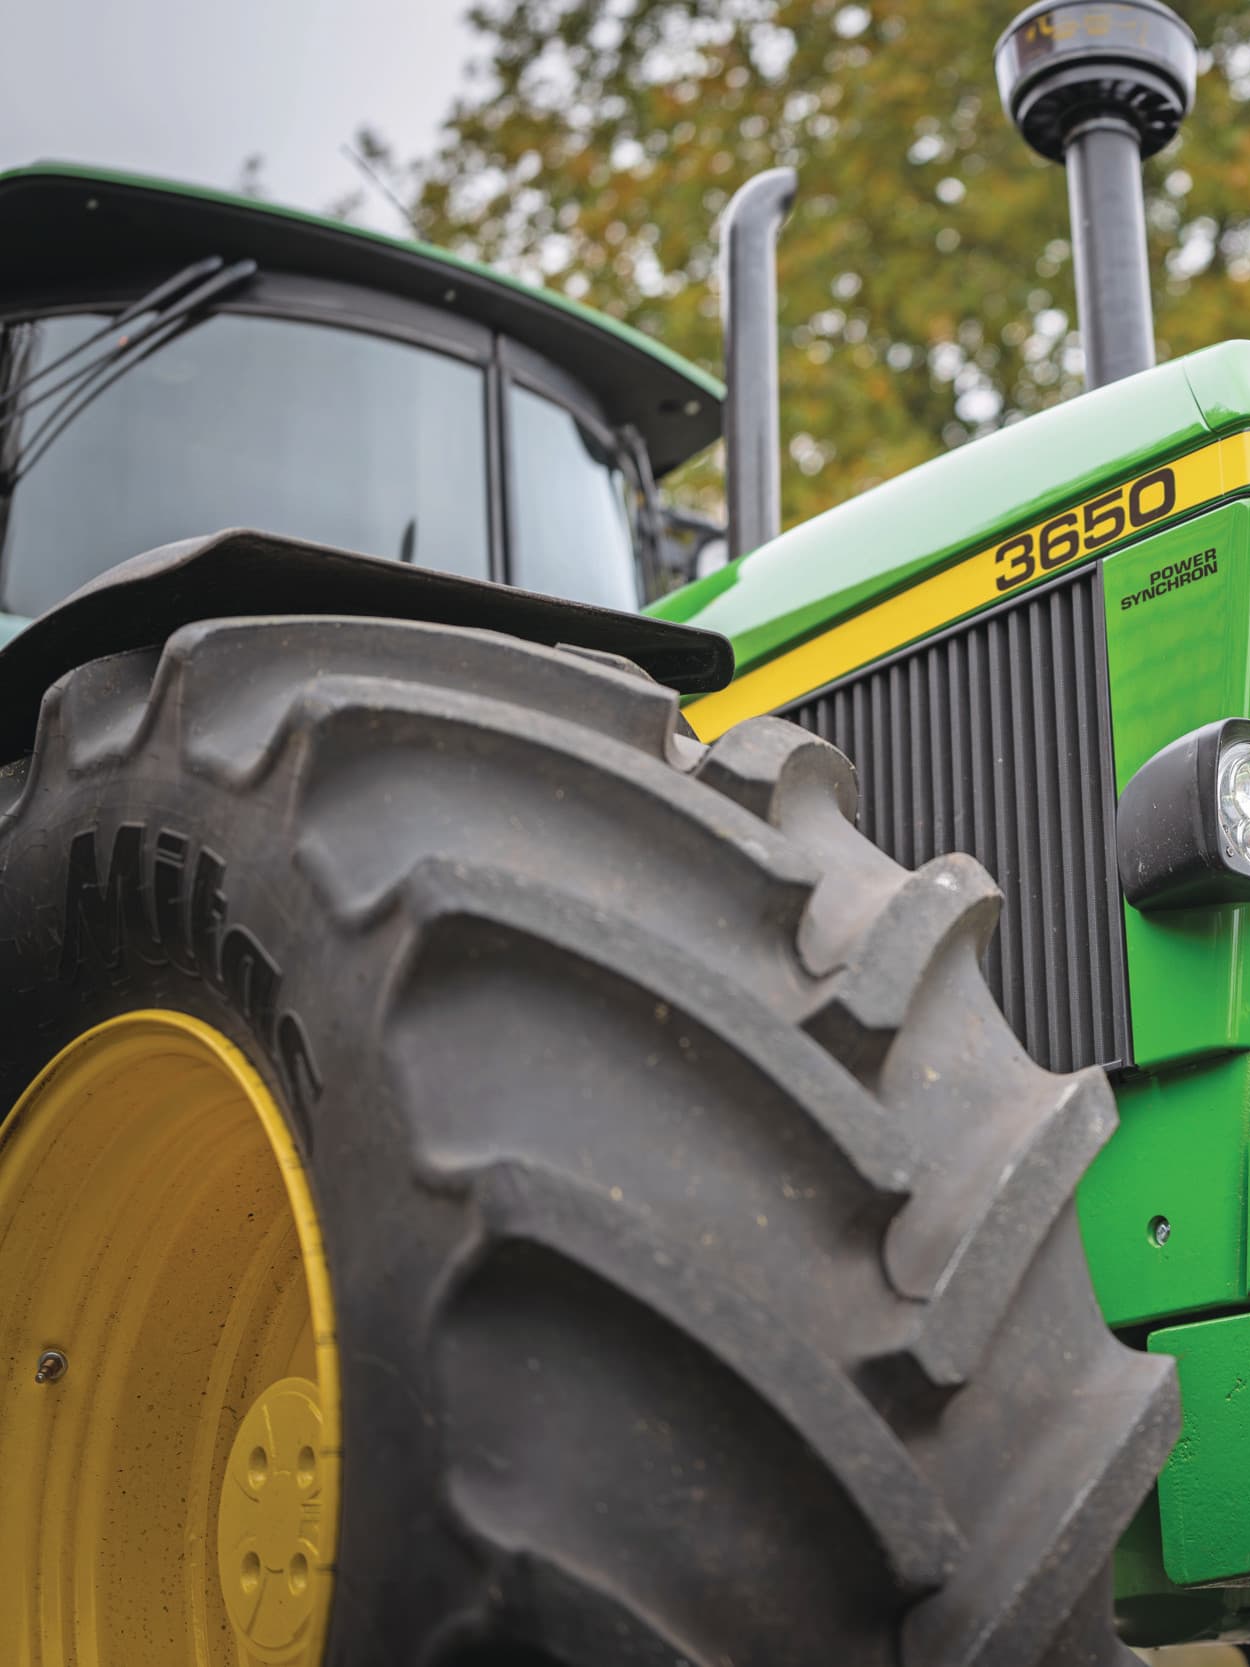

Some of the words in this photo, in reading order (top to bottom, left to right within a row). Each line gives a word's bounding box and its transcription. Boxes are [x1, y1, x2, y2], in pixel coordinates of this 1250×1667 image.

[995, 467, 1176, 592] 3650
[1120, 561, 1218, 610] SYNCHRON
[1150, 548, 1217, 585] POWER
